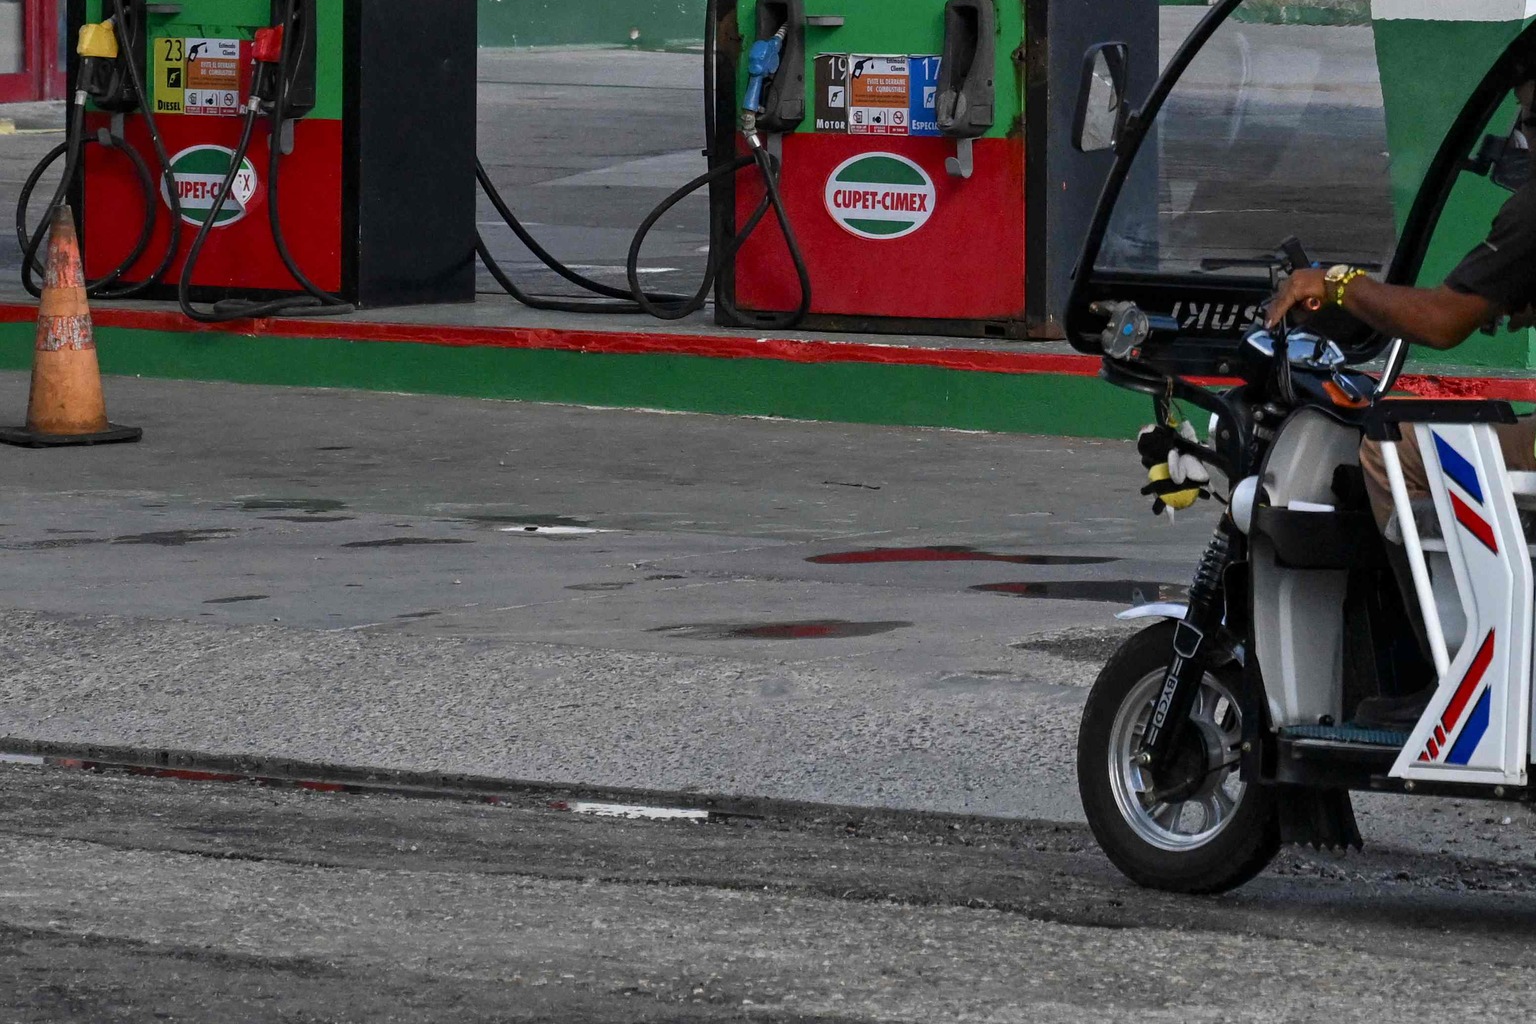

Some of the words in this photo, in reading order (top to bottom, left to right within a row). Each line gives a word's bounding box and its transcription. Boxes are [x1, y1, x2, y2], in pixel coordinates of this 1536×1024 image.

[165, 40, 182, 61] 23
[828, 56, 847, 80] 19
[922, 57, 942, 80] 17
[158, 99, 181, 110] DIESEL
[816, 118, 846, 129] MOTOR
[833, 189, 928, 212] CUPET-CIMEX
[1155, 678, 1176, 724] BYCD
